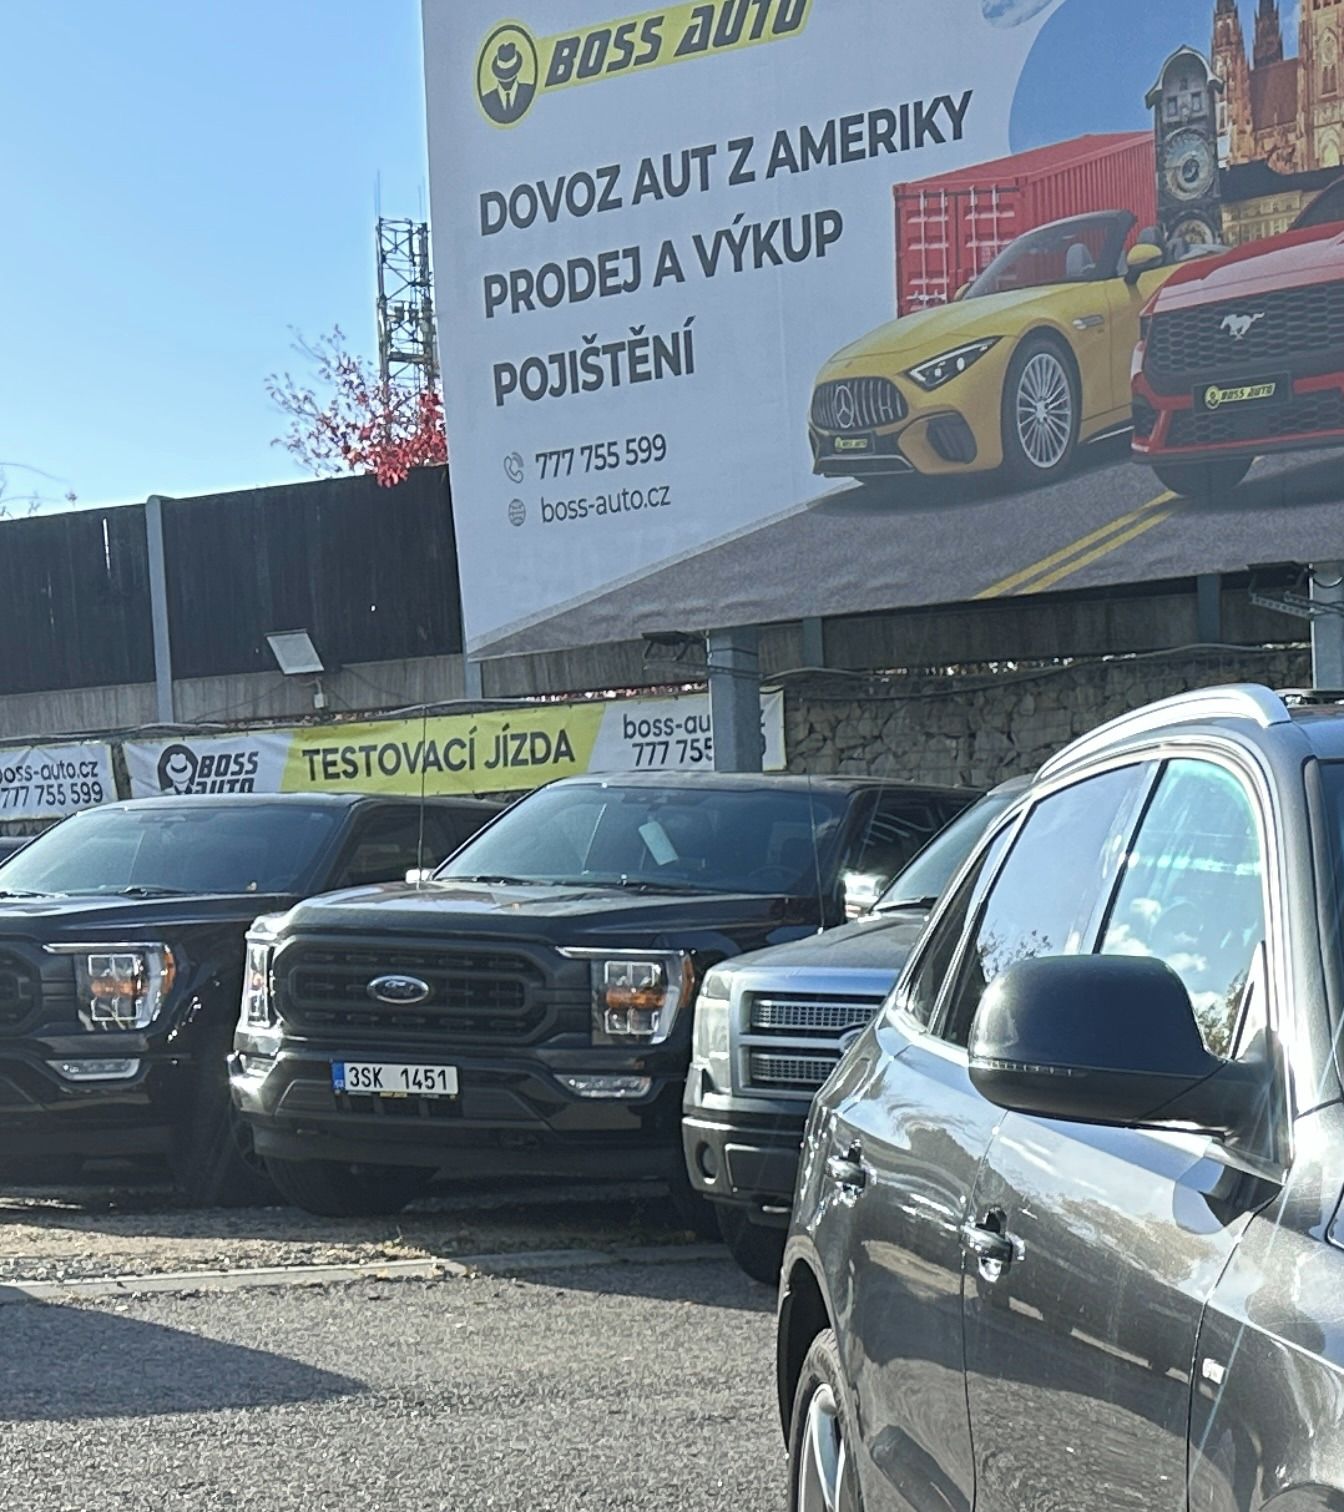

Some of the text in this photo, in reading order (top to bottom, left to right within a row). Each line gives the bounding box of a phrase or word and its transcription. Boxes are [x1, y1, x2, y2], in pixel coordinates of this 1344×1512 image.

[545, 0, 806, 88] BOSS AUTO
[480, 89, 974, 236] DOVOZ AUT Z AMERIKY
[484, 209, 844, 319] PRODEJ A VÝKUP
[493, 316, 696, 406] POJIŠTĚNÍ
[535, 433, 667, 480] 777 755 599
[540, 485, 672, 523] boss-auto.cz
[623, 713, 712, 740] boss-au
[197, 751, 259, 779] BOSS
[302, 722, 576, 781] TESTOVACÍ JÍZDA
[632, 740, 669, 767] 777
[1, 781, 103, 809] 777 755 599
[349, 1067, 447, 1091] 3SK 1451
